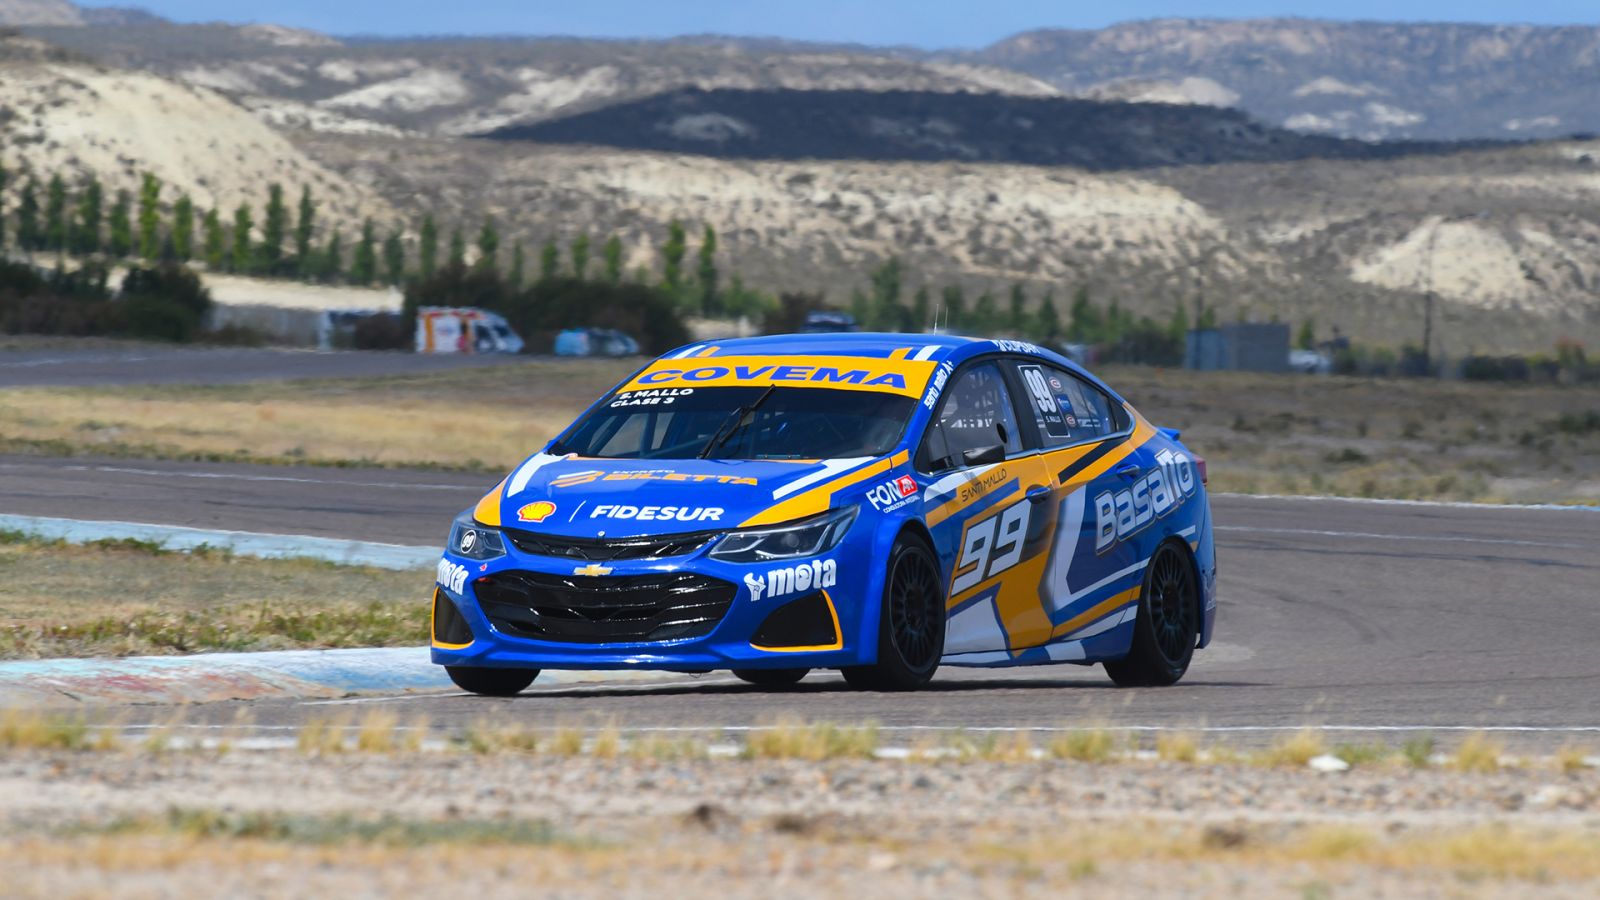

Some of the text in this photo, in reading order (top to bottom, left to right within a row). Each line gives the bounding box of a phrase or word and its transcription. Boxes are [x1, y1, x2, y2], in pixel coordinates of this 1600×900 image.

[637, 366, 906, 389] COVEMA
[634, 388, 694, 398] MALLO
[1024, 369, 1057, 413] 99
[610, 397, 661, 408] CLASE
[602, 473, 758, 486] BILETTA
[589, 504, 725, 522] FIDESUR
[461, 534, 475, 548] 99
[950, 500, 1031, 597] 99
[437, 557, 469, 595] mota
[767, 559, 837, 598] mota
